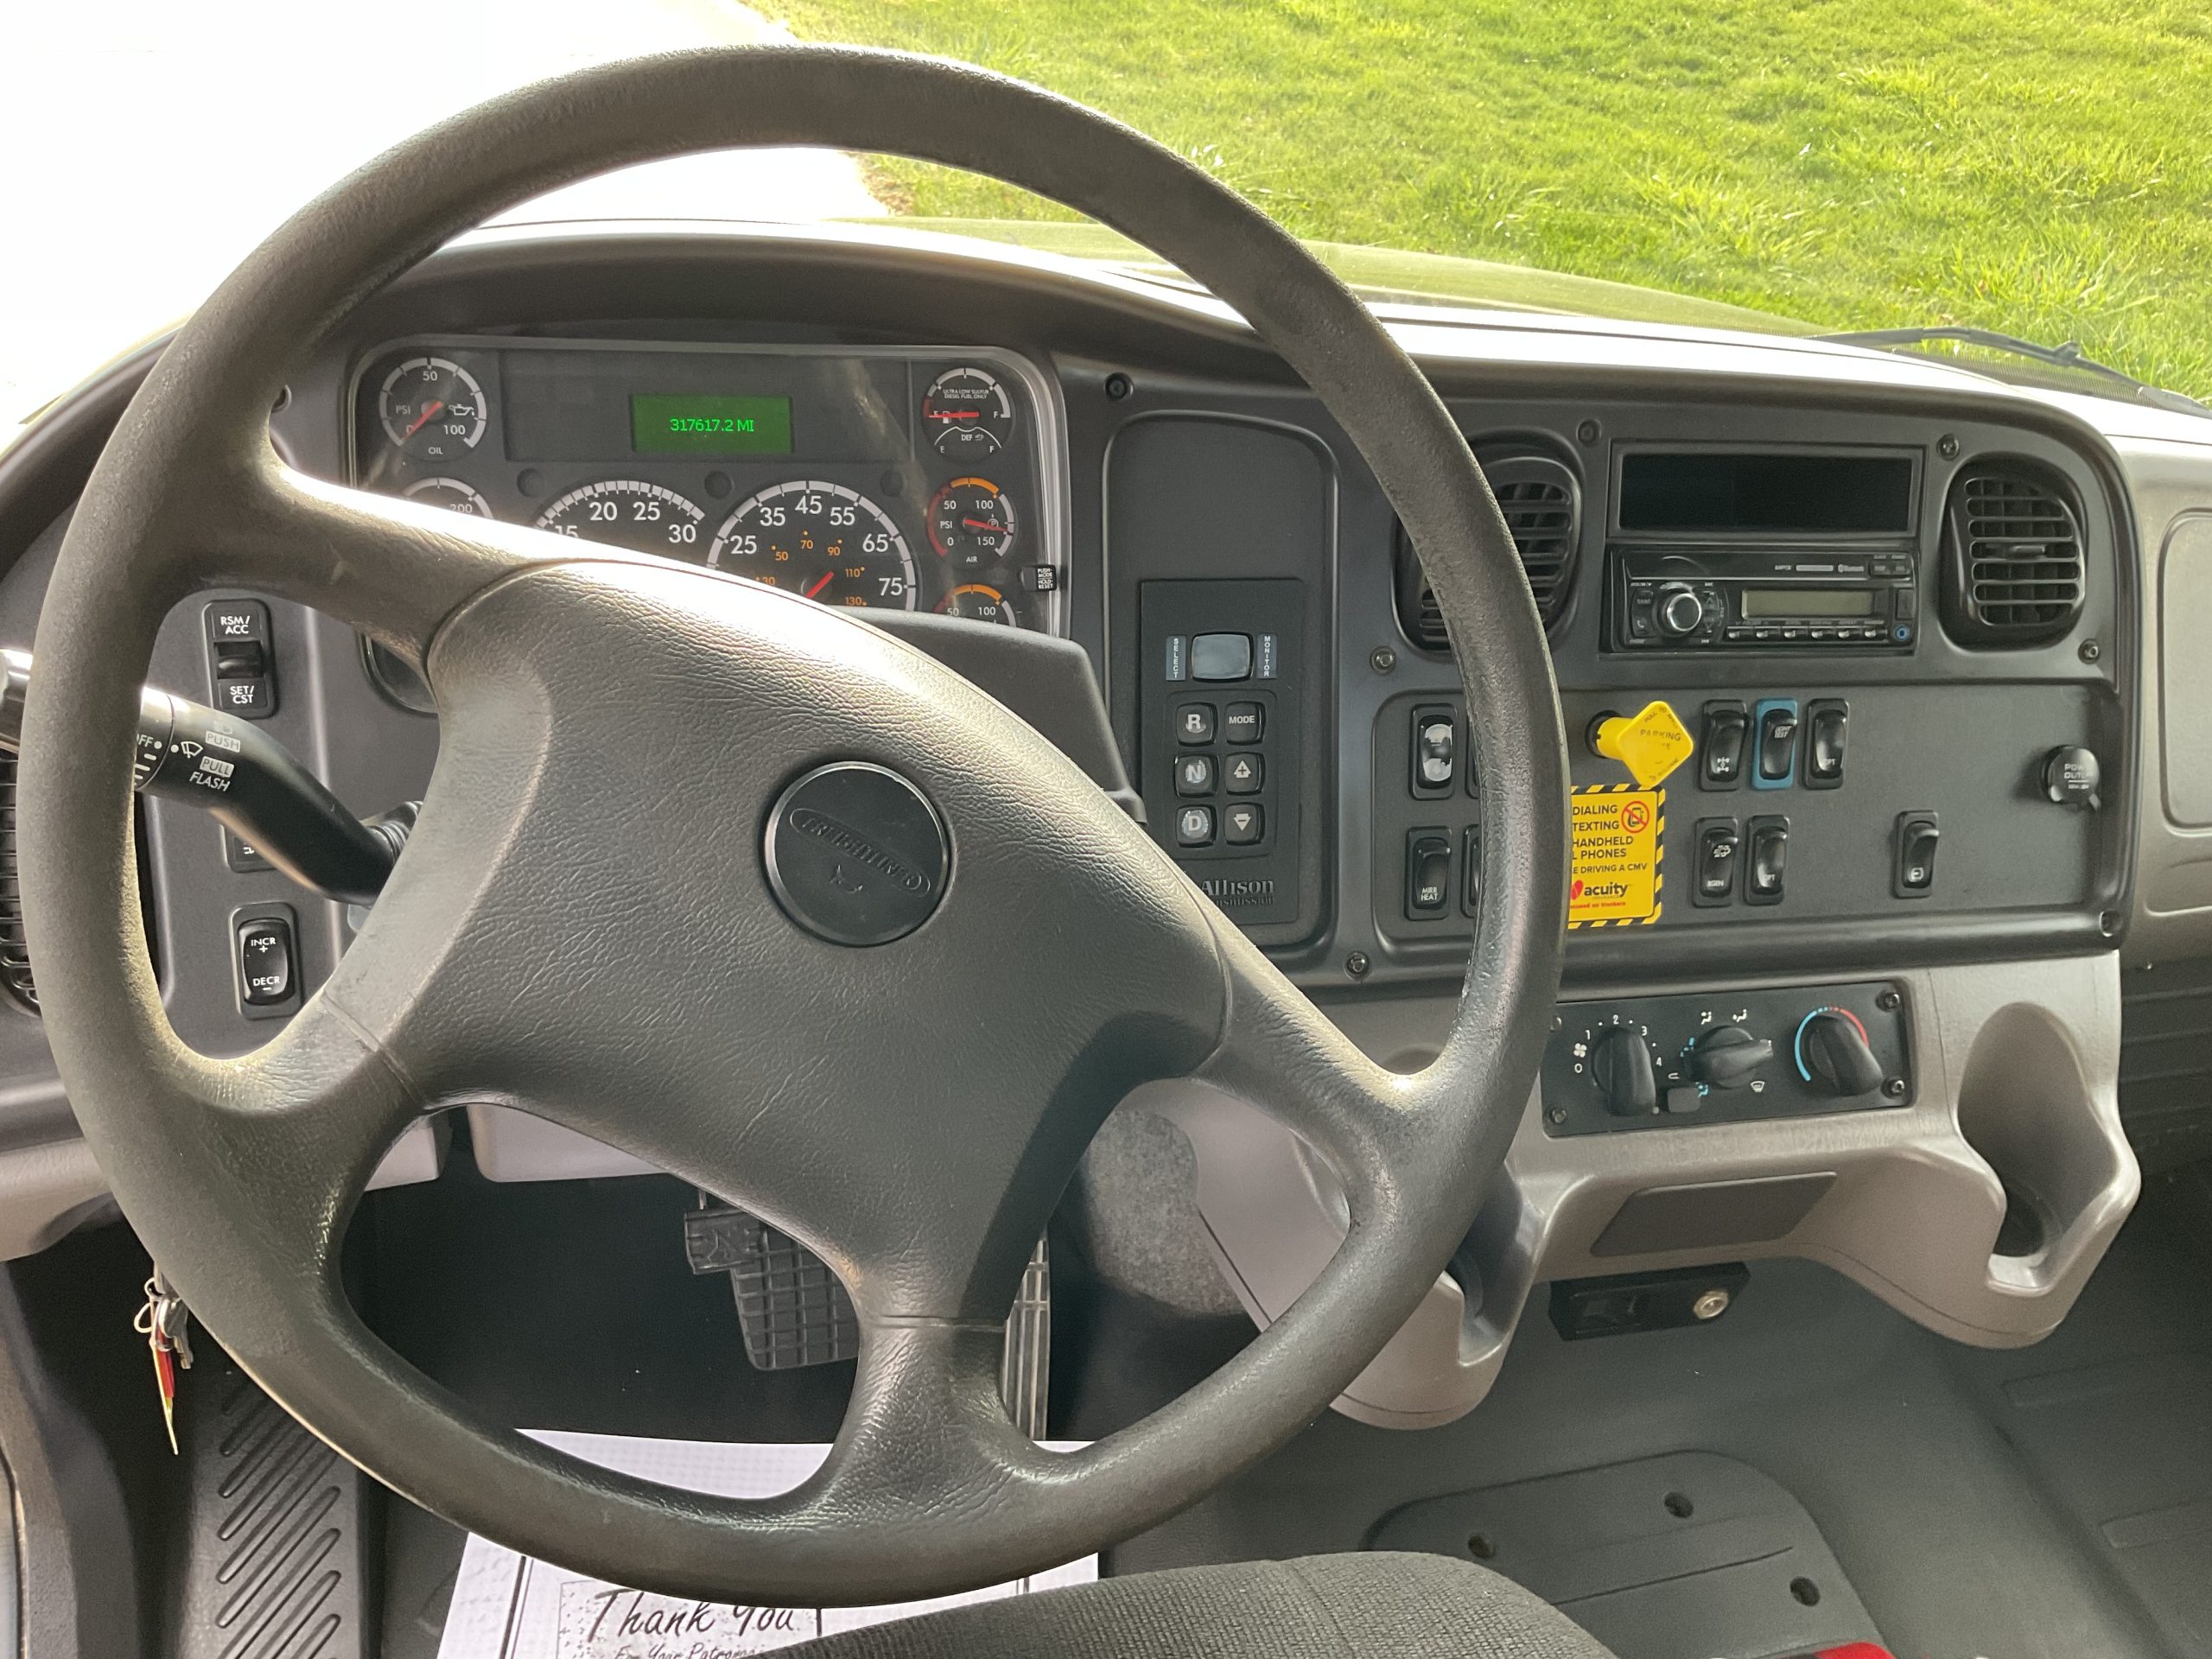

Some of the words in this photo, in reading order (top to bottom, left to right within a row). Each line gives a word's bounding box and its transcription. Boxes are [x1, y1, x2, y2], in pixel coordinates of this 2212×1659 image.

[423, 371, 438, 381] 50
[396, 405, 410, 414] PSI
[993, 410, 999, 419] F
[443, 424, 466, 435] 100
[670, 418, 734, 432] 317617.2
[737, 419, 754, 432] MI
[794, 495, 822, 515] 45
[943, 500, 957, 510] 50
[976, 499, 994, 510] 100
[588, 501, 618, 521] 20
[632, 501, 661, 521] 25
[760, 507, 786, 526] 35
[830, 506, 855, 526] 55
[940, 520, 953, 529] PSI
[668, 524, 696, 543] 30
[730, 535, 758, 555] 25
[800, 540, 814, 550] 70
[862, 533, 888, 553] 65
[947, 537, 954, 546] 0
[977, 537, 995, 546] 150
[775, 551, 789, 562] 50
[827, 546, 841, 556] 90
[845, 568, 861, 578] 110
[878, 577, 903, 596] 75
[845, 596, 862, 607] 130
[947, 607, 959, 617] 50
[978, 607, 996, 616] 100
[220, 615, 251, 626] RSM/
[225, 625, 249, 634] ACC
[230, 685, 255, 696] SET/
[232, 694, 254, 704] CST
[1187, 714, 1201, 729] R
[1229, 715, 1255, 724] MODE
[137, 734, 154, 747] FF
[207, 732, 240, 752] PUSH
[201, 758, 232, 777] PULL
[1188, 765, 1202, 781] N
[189, 772, 231, 791] FLASH
[1573, 804, 1618, 816] DIALING
[1188, 815, 1202, 831] D
[1573, 820, 1619, 832] TEXTING
[1573, 836, 1634, 848] HANDHELD
[1580, 848, 1627, 861] PHONES
[1580, 865, 1617, 874] DRIVING
[1202, 880, 1274, 896] Allison
[1584, 881, 1629, 898] acuity
[1421, 893, 1439, 901] HEAT
[251, 937, 276, 946] INCR
[252, 976, 281, 986] DECR
[1612, 1014, 1619, 1025] 2
[1585, 1029, 1591, 1039] 1
[1642, 1026, 1648, 1036] 3
[1656, 1057, 1662, 1066] 4
[588, 1587, 715, 1643] Thank
[733, 1605, 796, 1637] You
